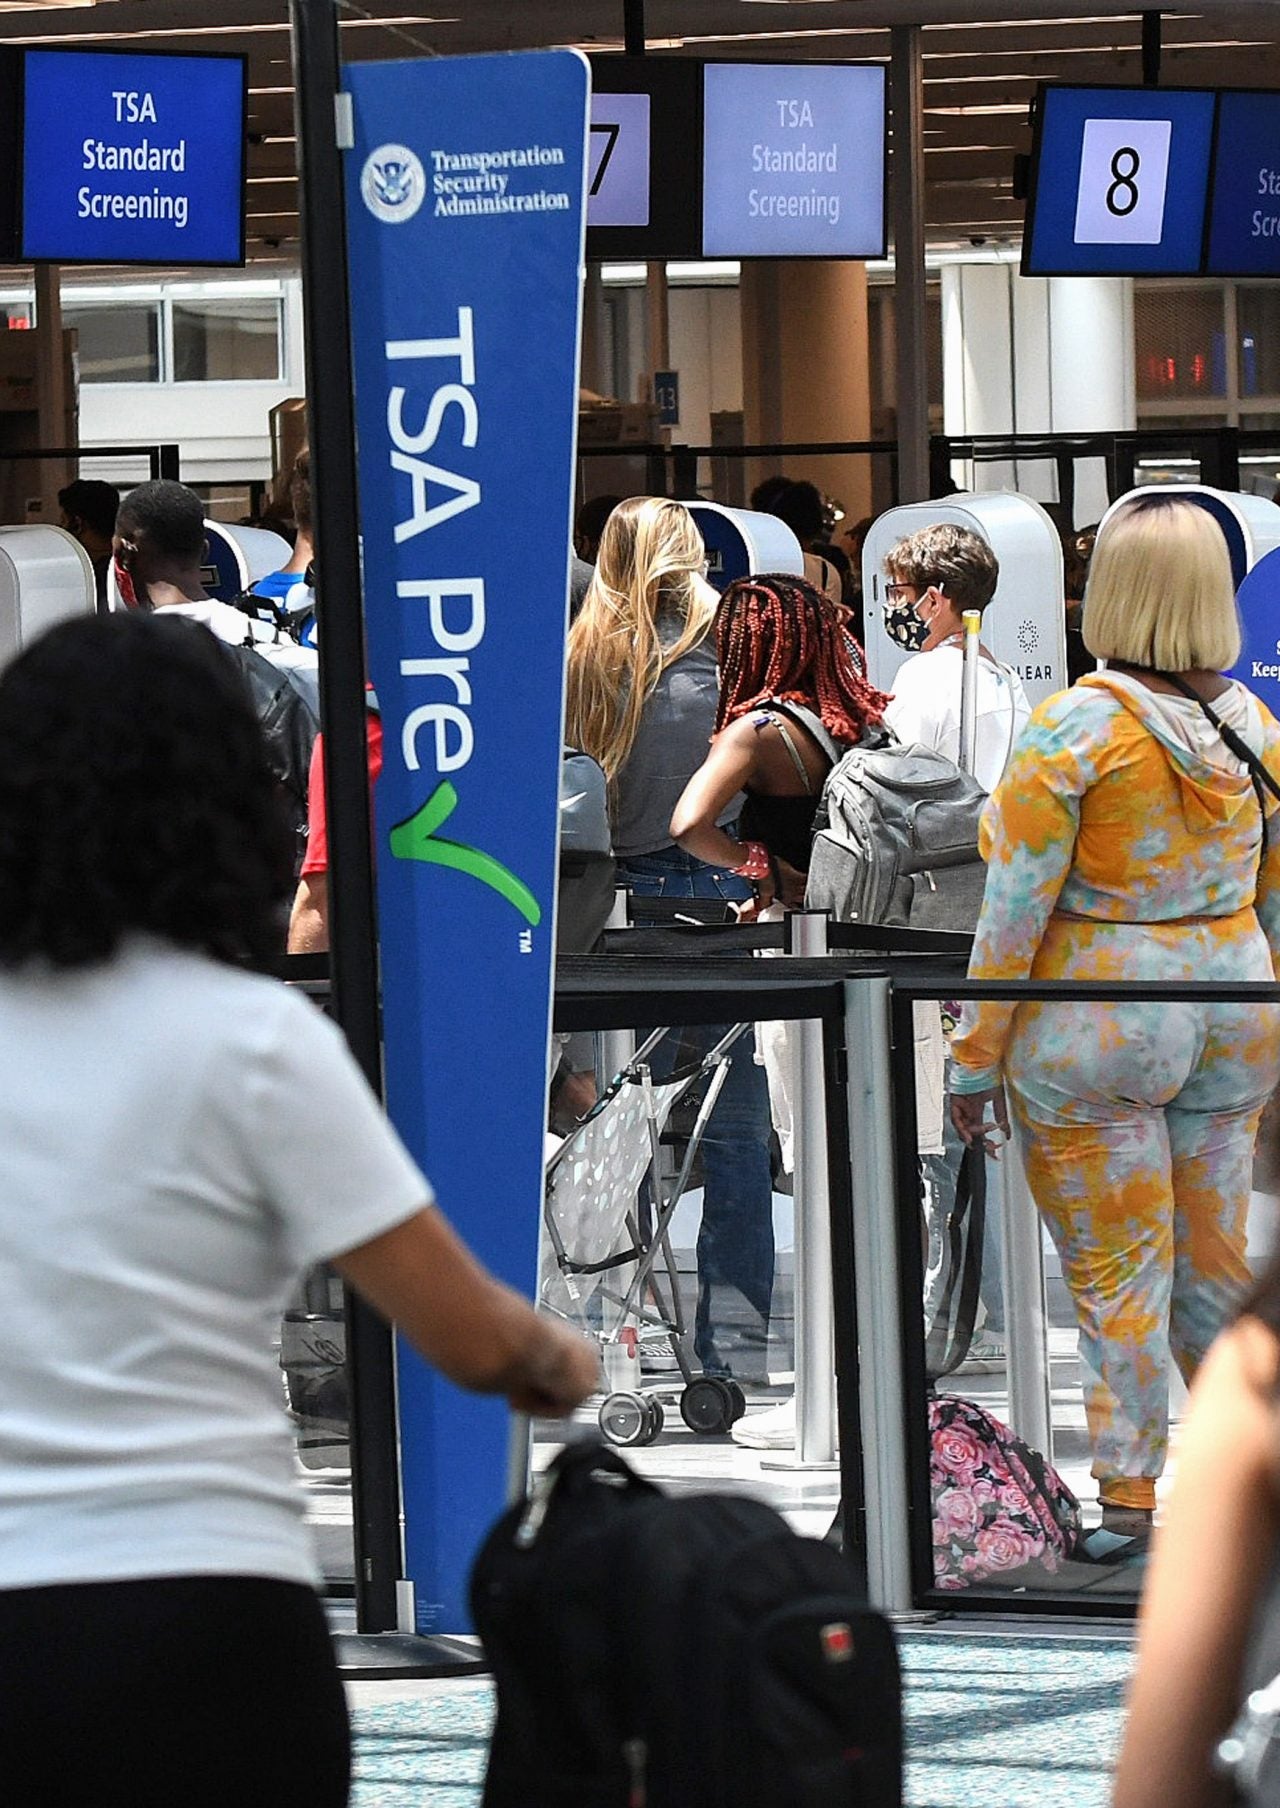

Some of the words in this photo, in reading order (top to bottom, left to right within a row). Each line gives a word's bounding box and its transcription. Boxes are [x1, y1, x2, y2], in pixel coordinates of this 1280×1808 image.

[112, 91, 157, 123] TSA
[776, 99, 814, 128] TSA
[82, 138, 186, 173] Standard
[430, 145, 565, 174] Transportation
[590, 123, 620, 196] 7
[752, 142, 837, 174] Standard
[433, 171, 508, 195] Security
[1105, 146, 1140, 217] 8
[77, 186, 189, 228] Screening
[434, 190, 570, 217] Administration
[748, 188, 840, 224] Screening
[657, 387, 676, 410] 13
[385, 306, 481, 544] TSA
[396, 577, 486, 772] Pre
